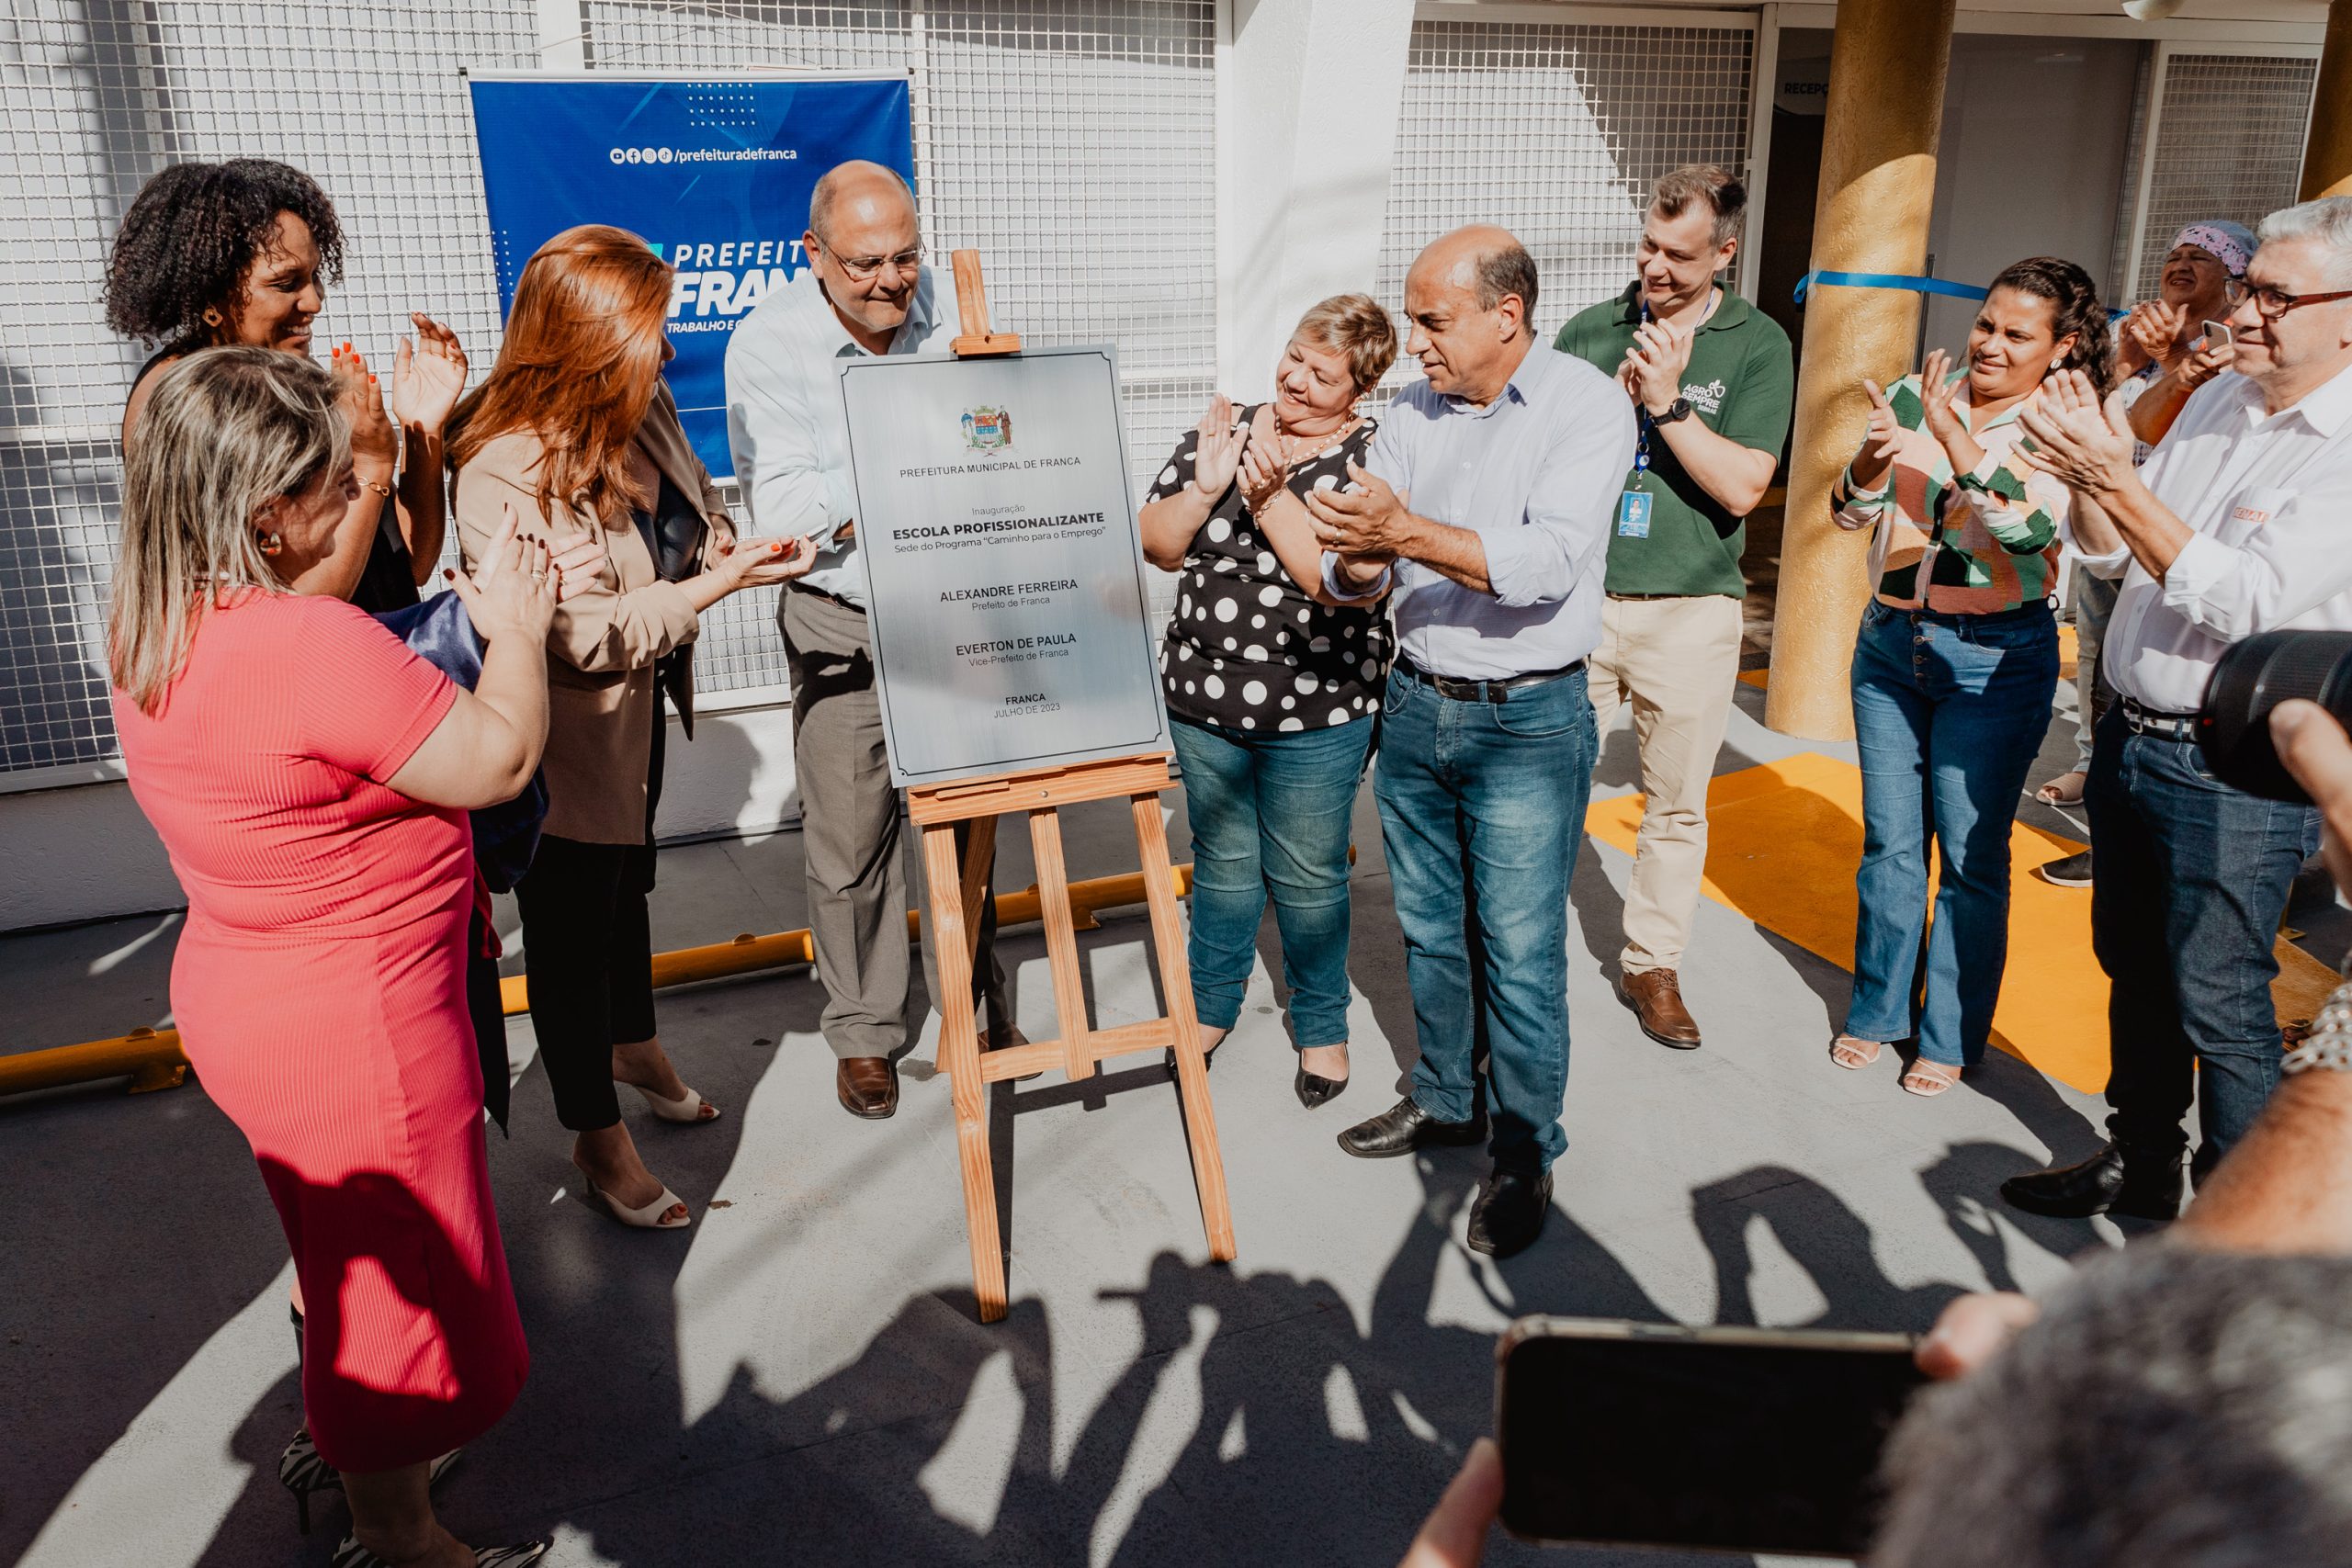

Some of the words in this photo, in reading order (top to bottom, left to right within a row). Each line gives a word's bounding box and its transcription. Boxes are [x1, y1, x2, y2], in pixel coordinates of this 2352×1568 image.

[673, 147, 797, 164] /prefeituradefranca
[666, 321, 727, 334] TRABALHO
[727, 320, 735, 331] E
[1683, 383, 1713, 397] AGRO
[1681, 390, 1720, 408] SEMPRE
[899, 466, 965, 478] PREFEITURA
[967, 461, 1022, 473] MUNICIPAL
[1023, 459, 1037, 468] DE
[1040, 457, 1081, 468] FRANCA
[971, 504, 1025, 516] Inauguração
[893, 525, 950, 539] ESCOLA
[954, 512, 1105, 536] PROFISSIONALIZANTE
[894, 543, 919, 554] Sede
[921, 542, 933, 551] do
[935, 538, 982, 550] Programa
[1032, 533, 1052, 543] para
[940, 585, 1015, 603] ALEXANDRE
[1018, 579, 1079, 594] FERREIRA
[971, 600, 1006, 611] Prefeito
[1008, 599, 1019, 608] de
[1021, 596, 1050, 606] Franca
[956, 639, 1014, 656] EVERTON
[1017, 637, 1035, 649] DE
[1037, 633, 1077, 647] PAULA
[968, 653, 1024, 667] Vice-Prefeito
[1026, 651, 1037, 660] de
[1039, 648, 1069, 659] Franca
[1005, 693, 1046, 705] FRANCA
[993, 706, 1023, 718] JULHO
[1025, 705, 1038, 715] DE
[1040, 702, 1061, 713] 2023
